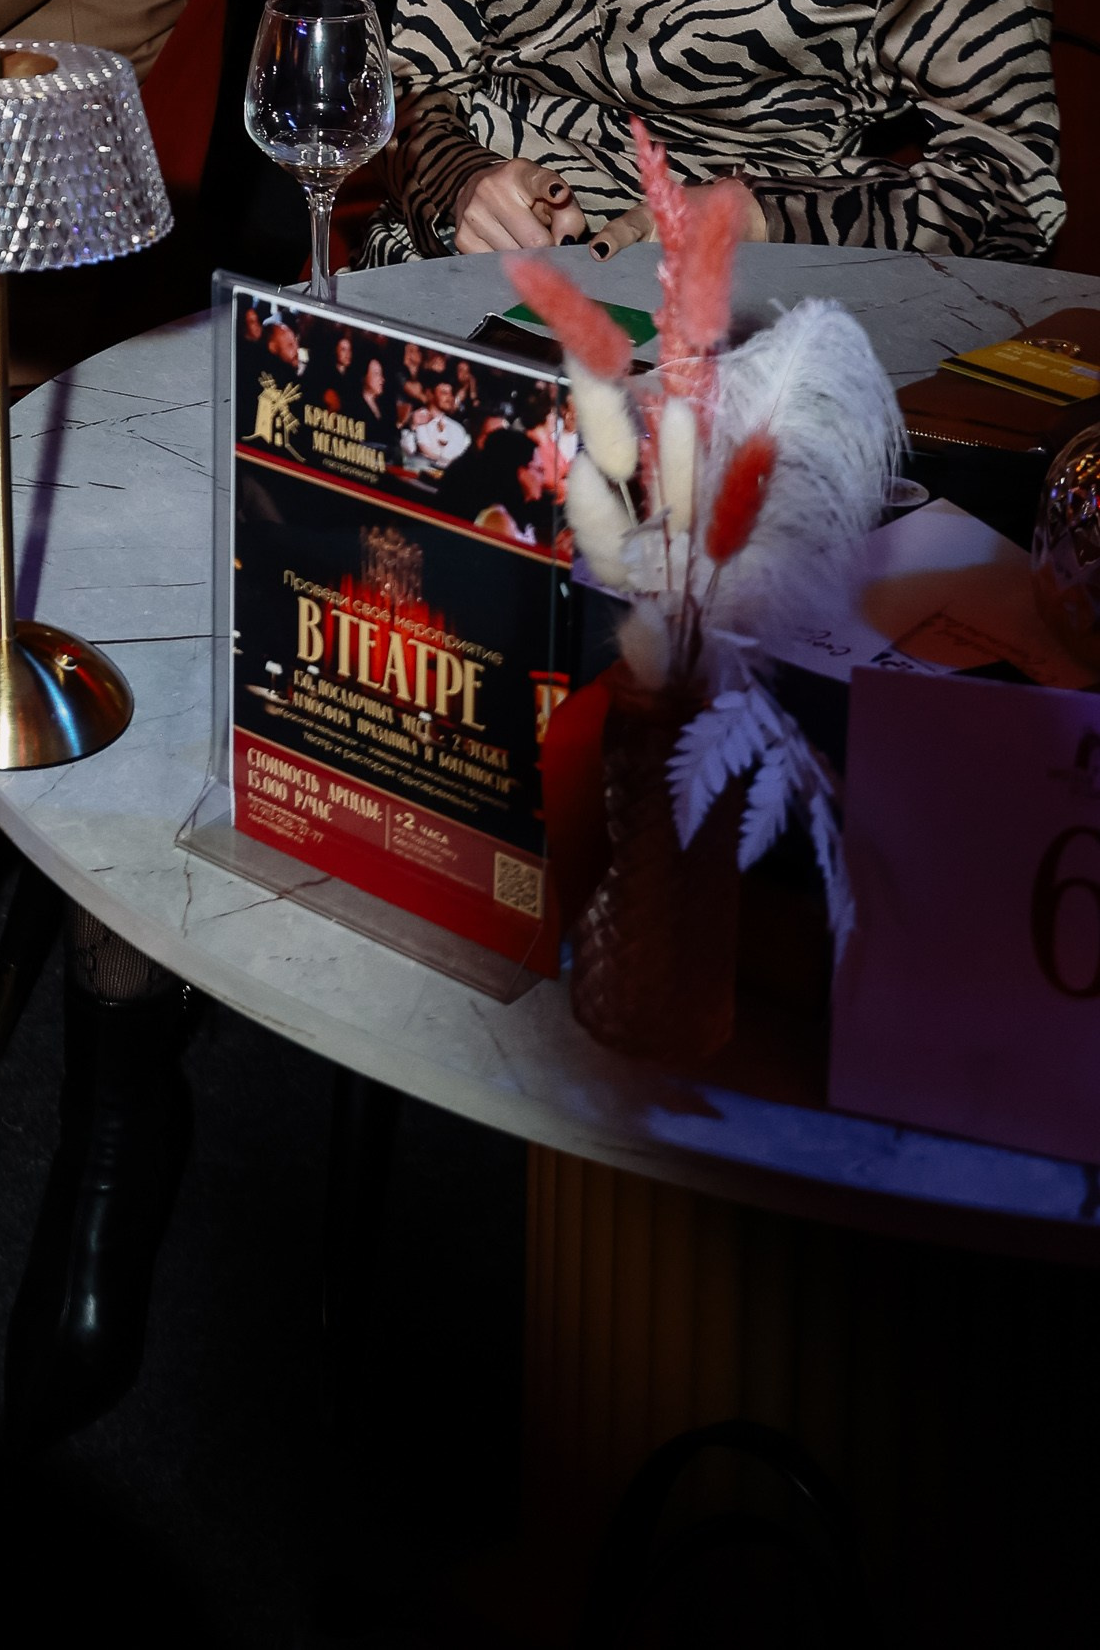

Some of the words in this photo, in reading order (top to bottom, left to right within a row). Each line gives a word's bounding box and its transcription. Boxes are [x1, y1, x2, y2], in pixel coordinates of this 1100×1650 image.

[303, 403, 366, 441] КРАСНАЯ
[312, 429, 387, 474] МЕЛЬНИЦА
[282, 568, 351, 608] Проведи
[393, 612, 505, 666] мероприятие
[296, 596, 325, 663] В
[330, 608, 487, 732] ТЕАТРЕ
[451, 733, 462, 752] 2
[246, 746, 321, 793] СТОИМОСТЬ
[328, 782, 383, 823] АРЕНДЫ:
[246, 769, 288, 802] 15.000
[1031, 825, 1100, 998] 6
